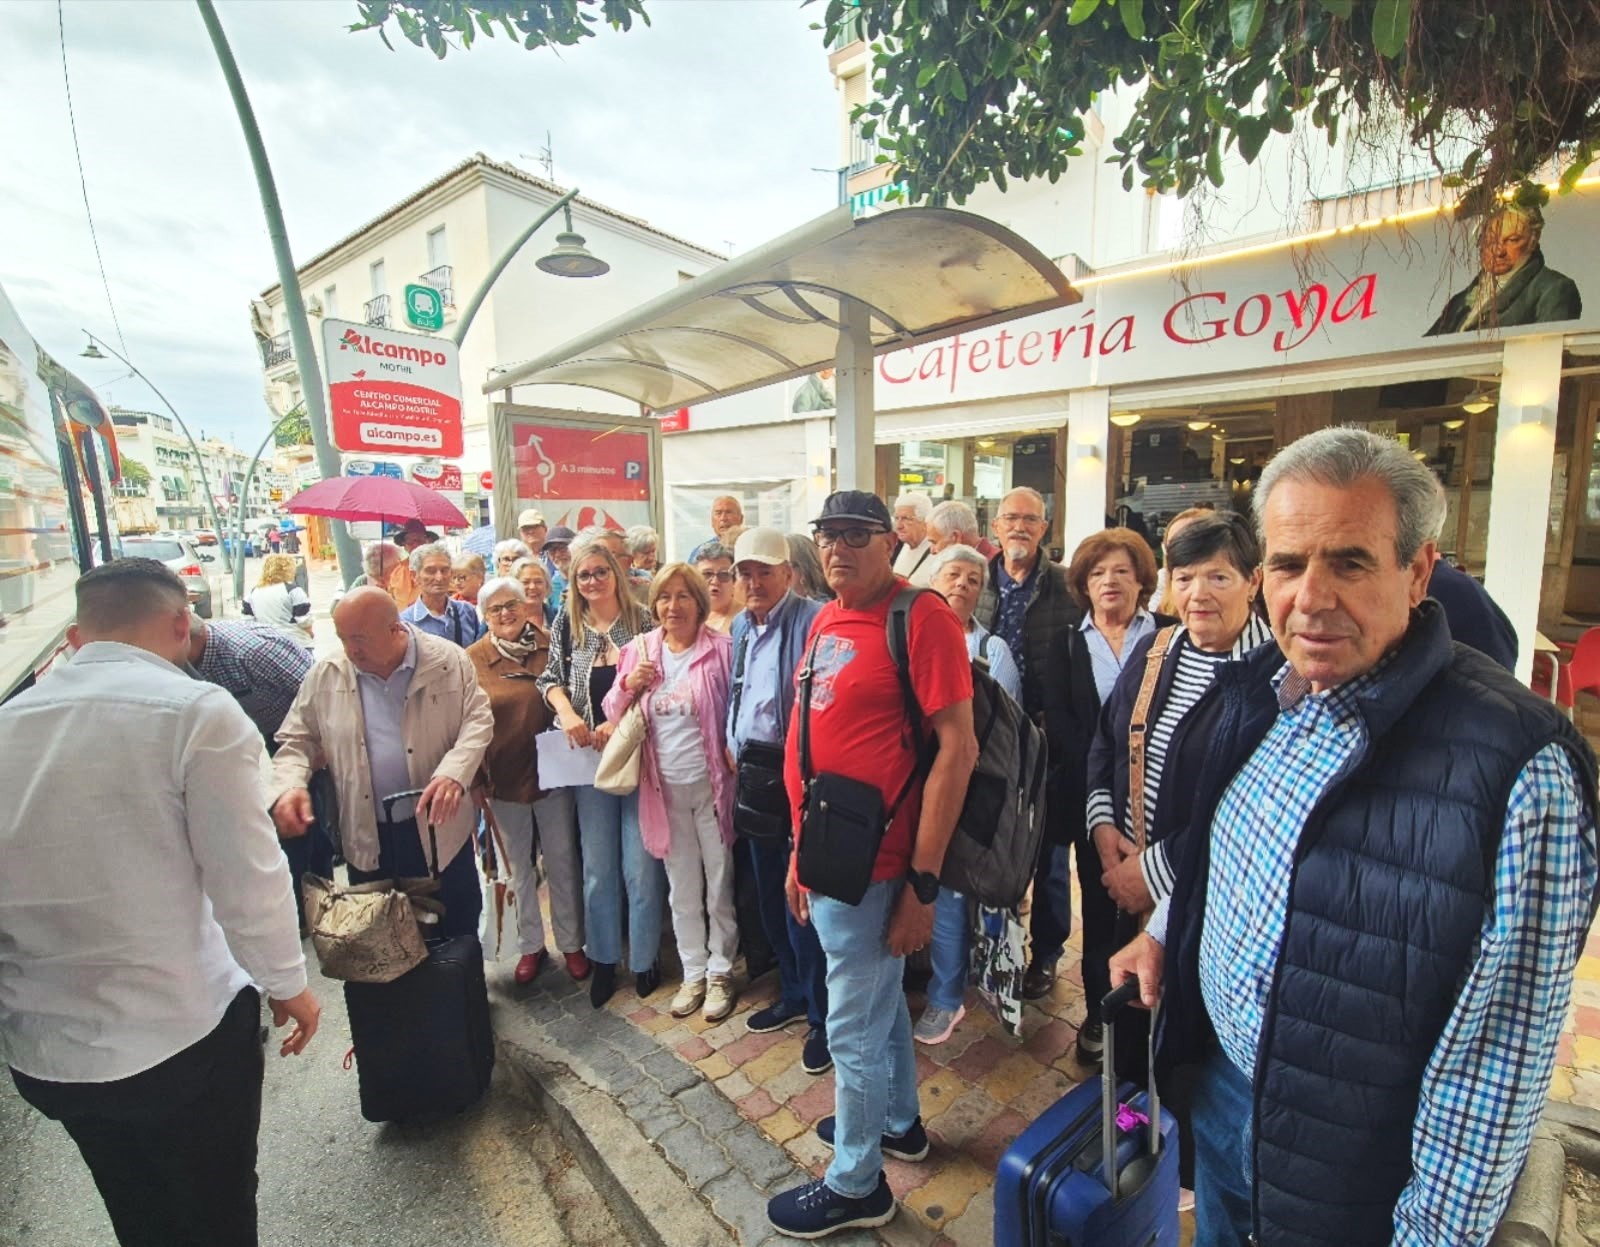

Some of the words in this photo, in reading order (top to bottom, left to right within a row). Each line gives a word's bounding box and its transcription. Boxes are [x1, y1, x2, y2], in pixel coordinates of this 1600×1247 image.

[417, 317, 435, 328] BUS
[880, 309, 1137, 394] Cafetería
[1163, 273, 1378, 352] Goya
[339, 328, 447, 367] Alcampo
[353, 389, 391, 401] CENTRO
[393, 394, 442, 407] COMERCIAL
[360, 400, 405, 412] ALCAMPO
[406, 405, 438, 416] MOTRIL
[366, 427, 438, 443] alcampo.es
[560, 464, 568, 473] A
[569, 464, 576, 473] 3
[577, 466, 617, 476] minutos
